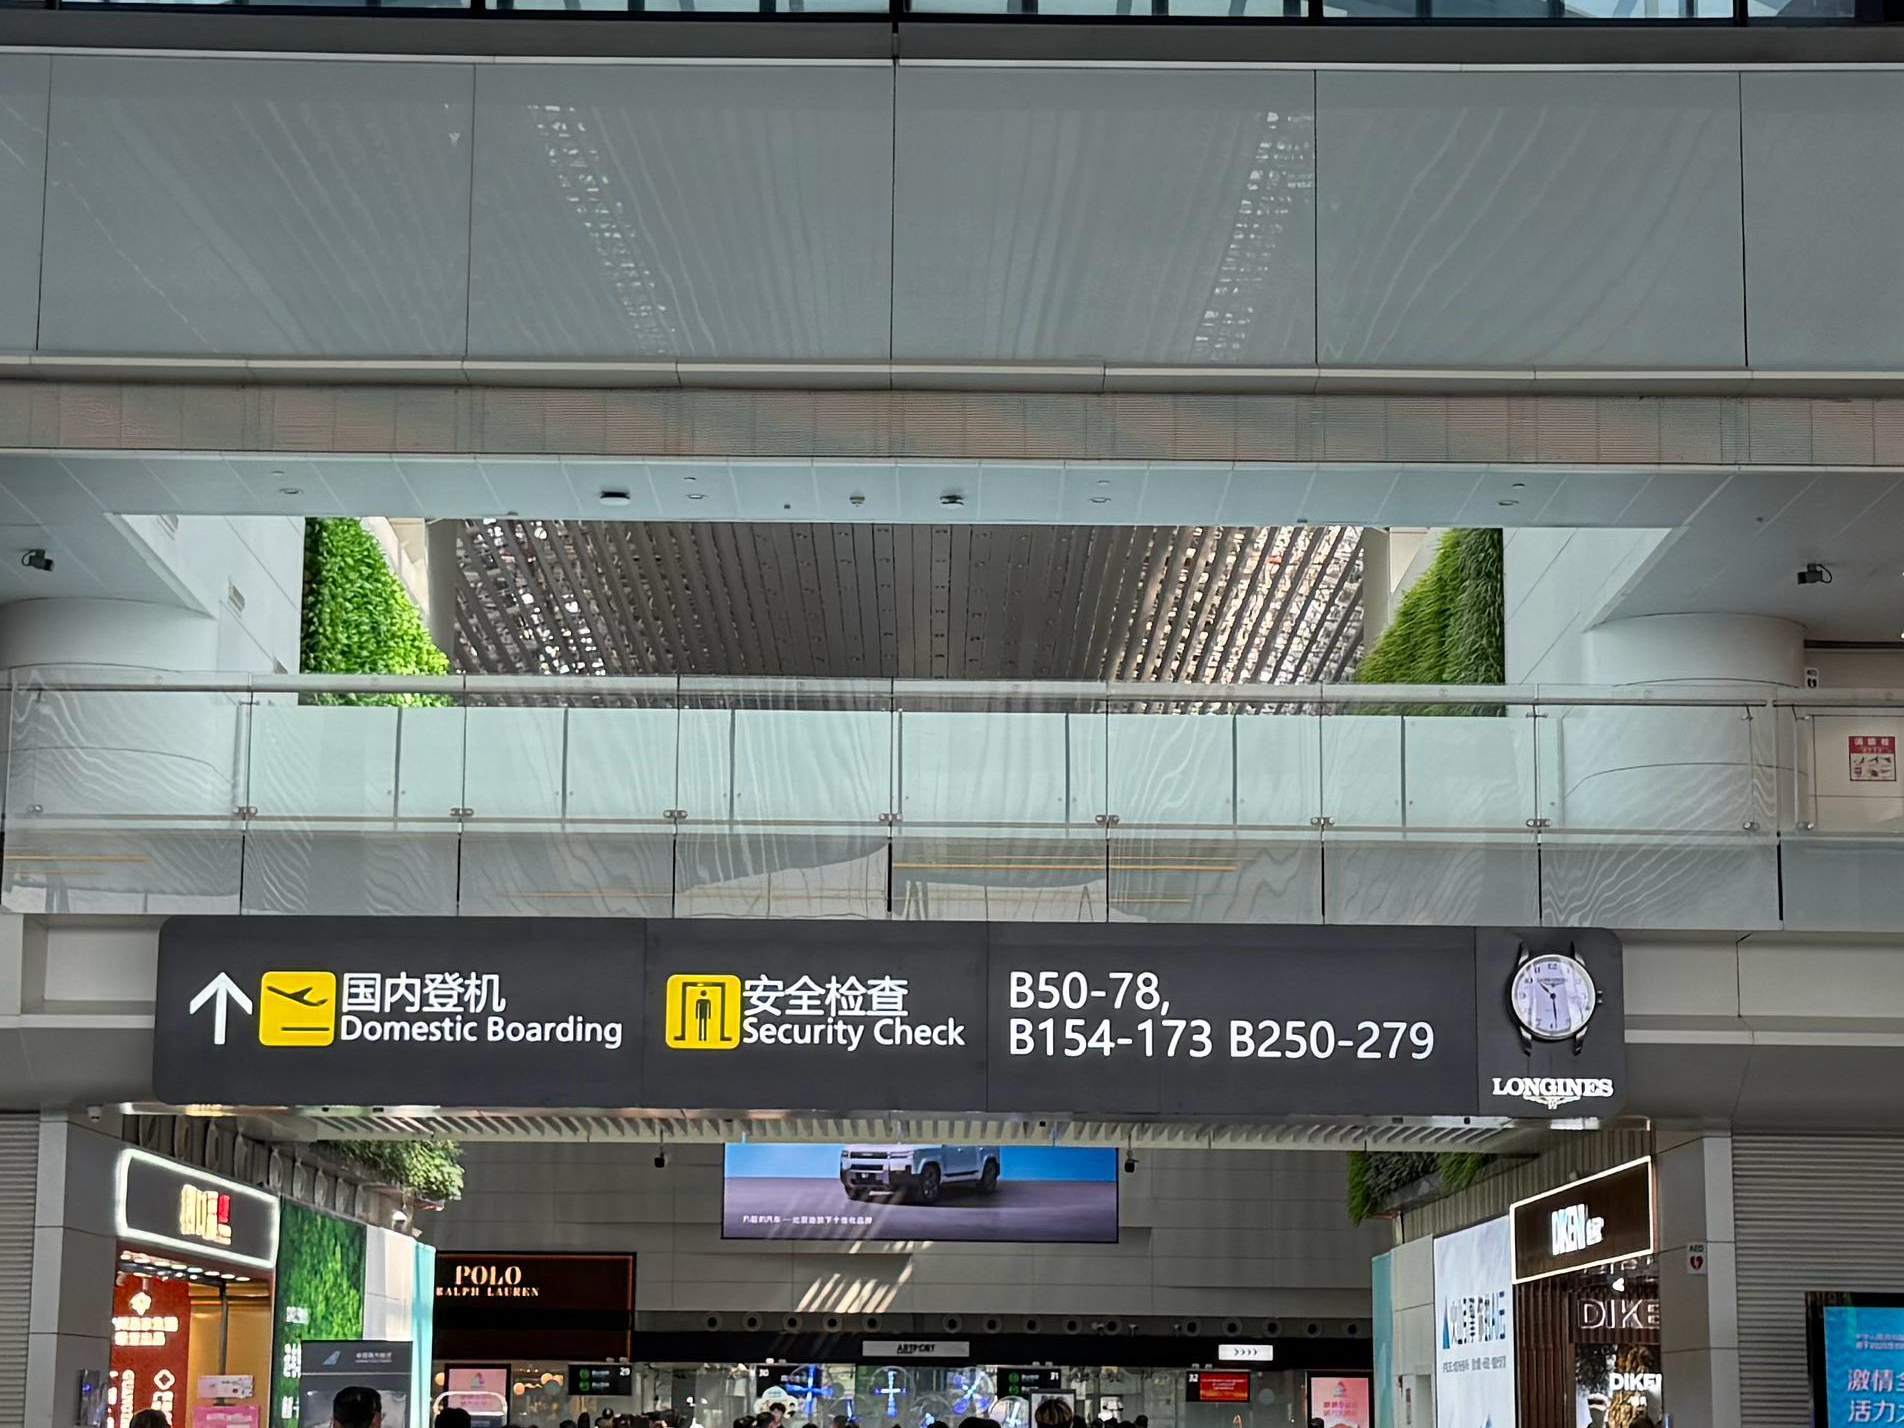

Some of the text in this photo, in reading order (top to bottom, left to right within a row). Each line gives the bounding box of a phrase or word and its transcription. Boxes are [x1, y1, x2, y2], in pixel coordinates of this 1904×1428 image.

[341, 972, 507, 1014] 国内登机
[742, 974, 910, 1018] 安全检查
[1009, 971, 1171, 1016] B50-78,
[340, 1015, 624, 1050] Domestic Boarding
[743, 1016, 967, 1053] Security Check
[1009, 1018, 1435, 1061] B154-173 B250-279
[1492, 1076, 1614, 1099] LONGINES
[455, 1264, 523, 1286] POLO
[487, 1286, 540, 1298] LAUREN
